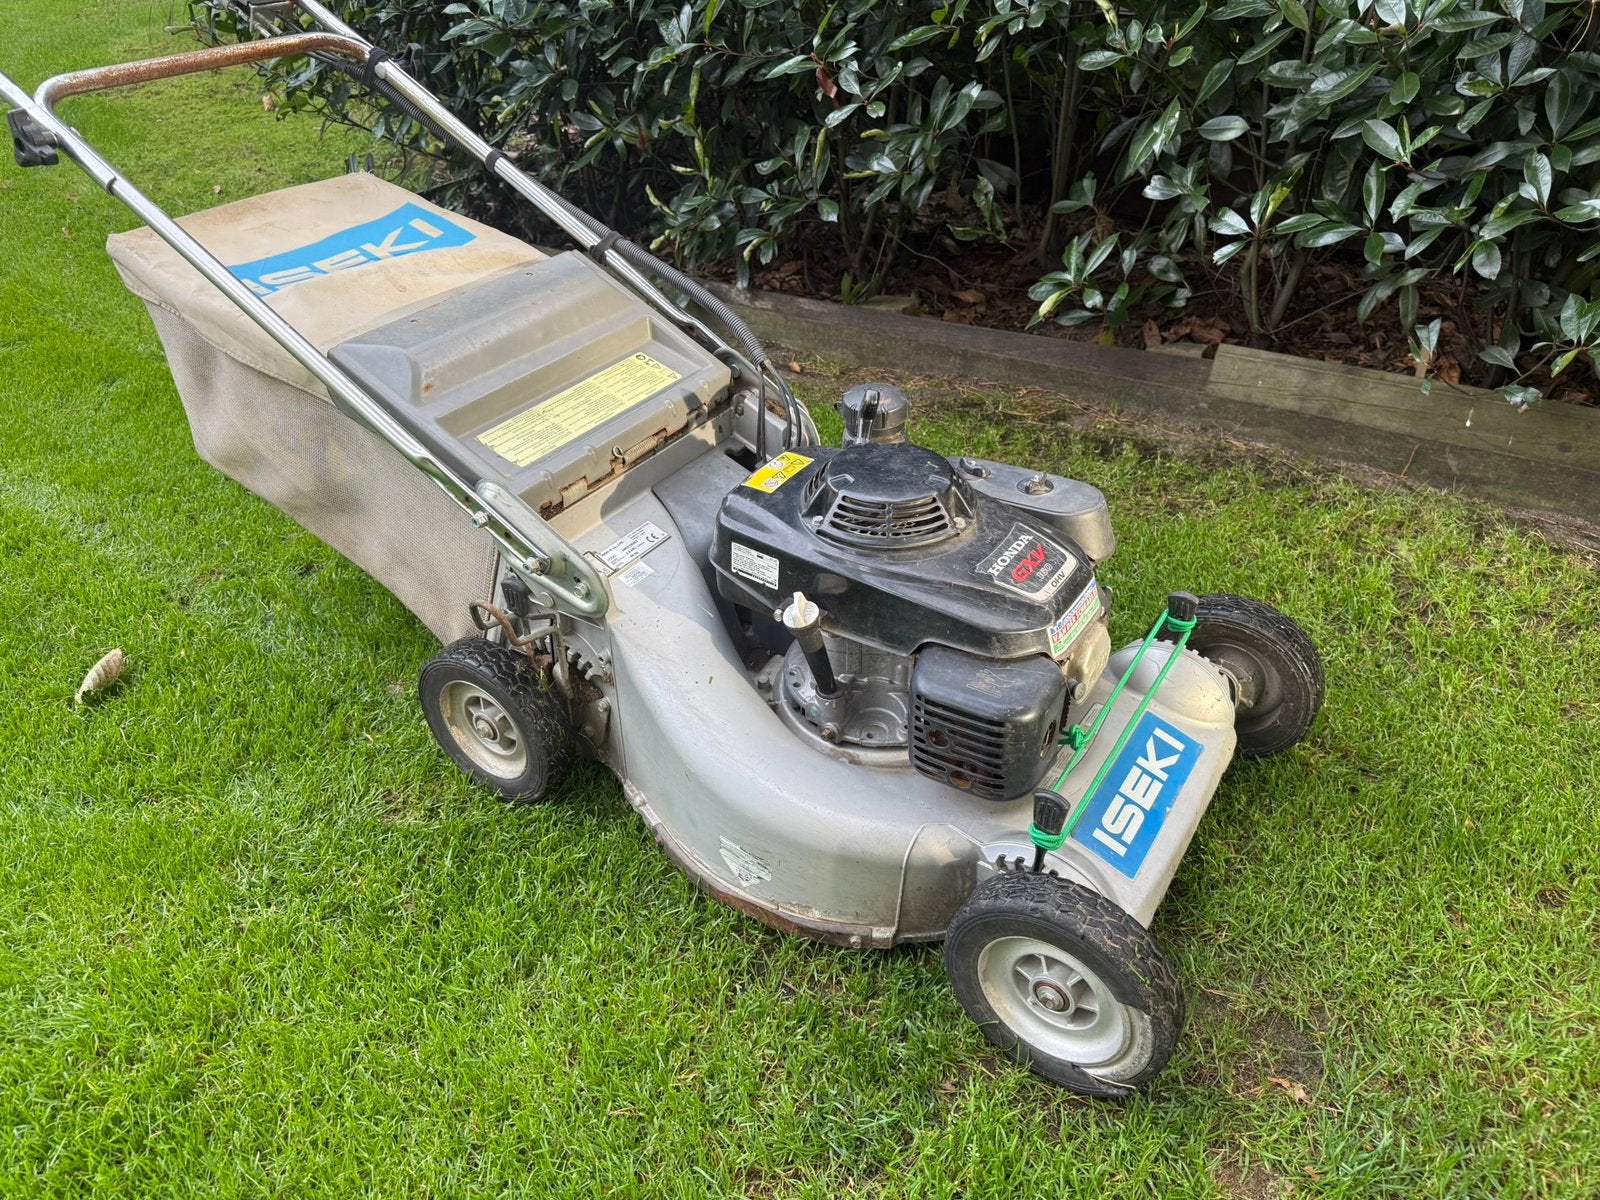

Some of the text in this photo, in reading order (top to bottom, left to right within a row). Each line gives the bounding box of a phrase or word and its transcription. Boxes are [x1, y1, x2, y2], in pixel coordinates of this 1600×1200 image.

[240, 218, 444, 296] ISEKI
[987, 534, 1033, 576] HONDA
[1011, 543, 1046, 583] GXV
[1036, 563, 1053, 581] 160
[1050, 571, 1066, 588] OHV
[1092, 727, 1185, 857] ISEKI
